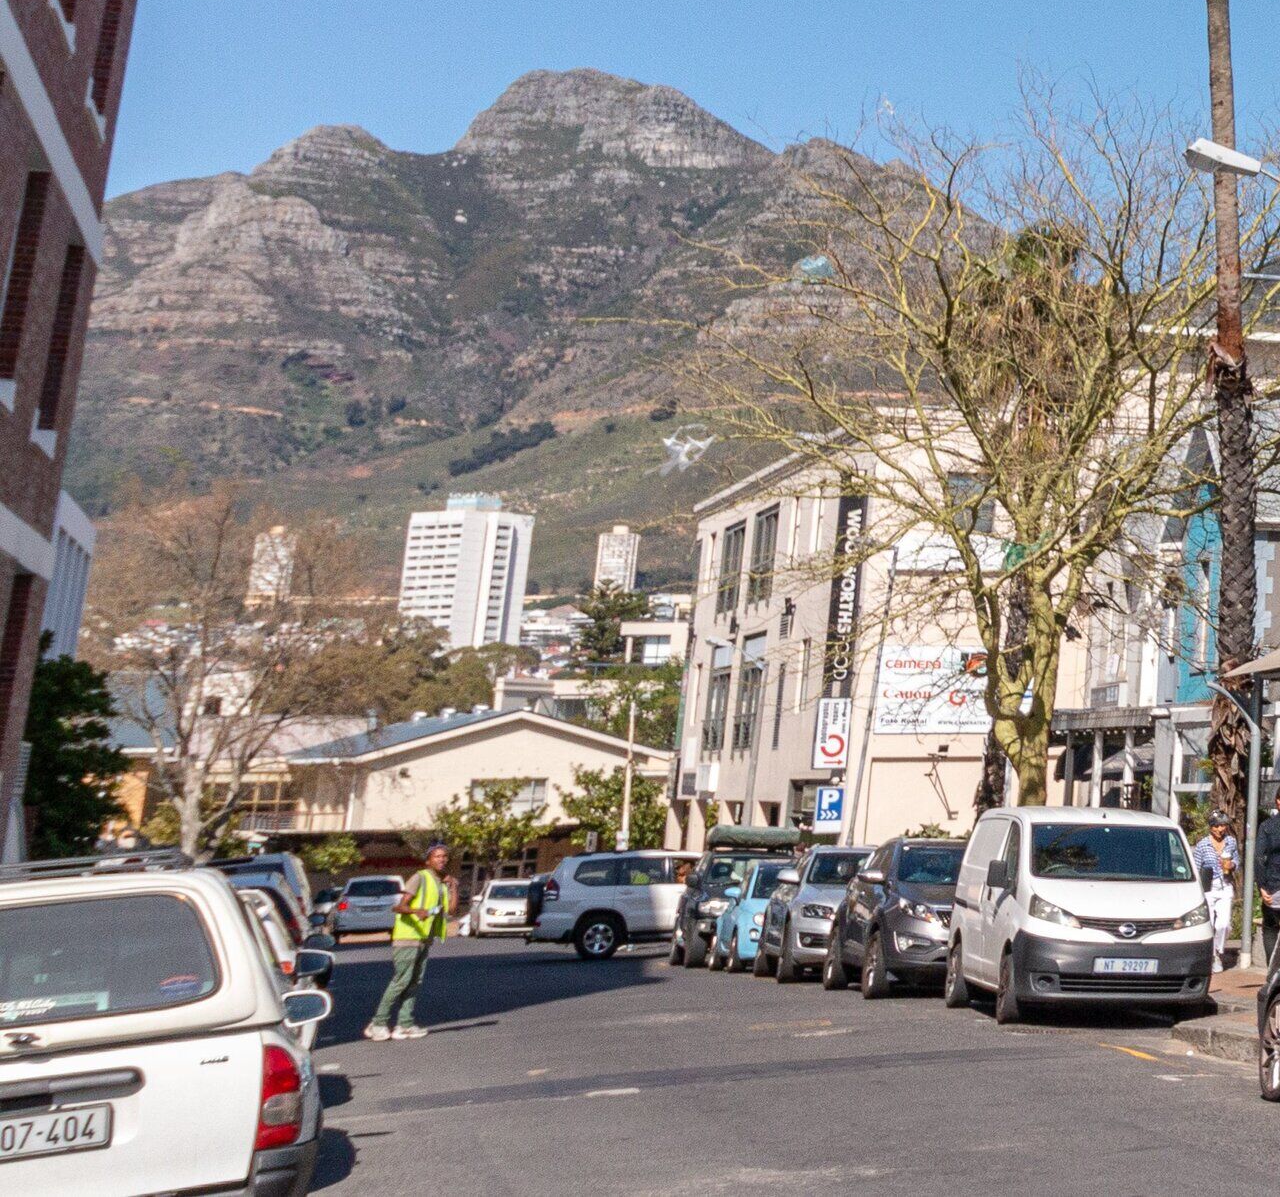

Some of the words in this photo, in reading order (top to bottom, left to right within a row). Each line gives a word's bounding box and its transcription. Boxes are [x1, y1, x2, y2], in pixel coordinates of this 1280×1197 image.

[837, 509, 862, 635] WOOWORTHS
[883, 689, 931, 699] Canon
[821, 789, 840, 810] P
[1104, 960, 1115, 971] NT
[1, 1113, 95, 1151] 07-404
